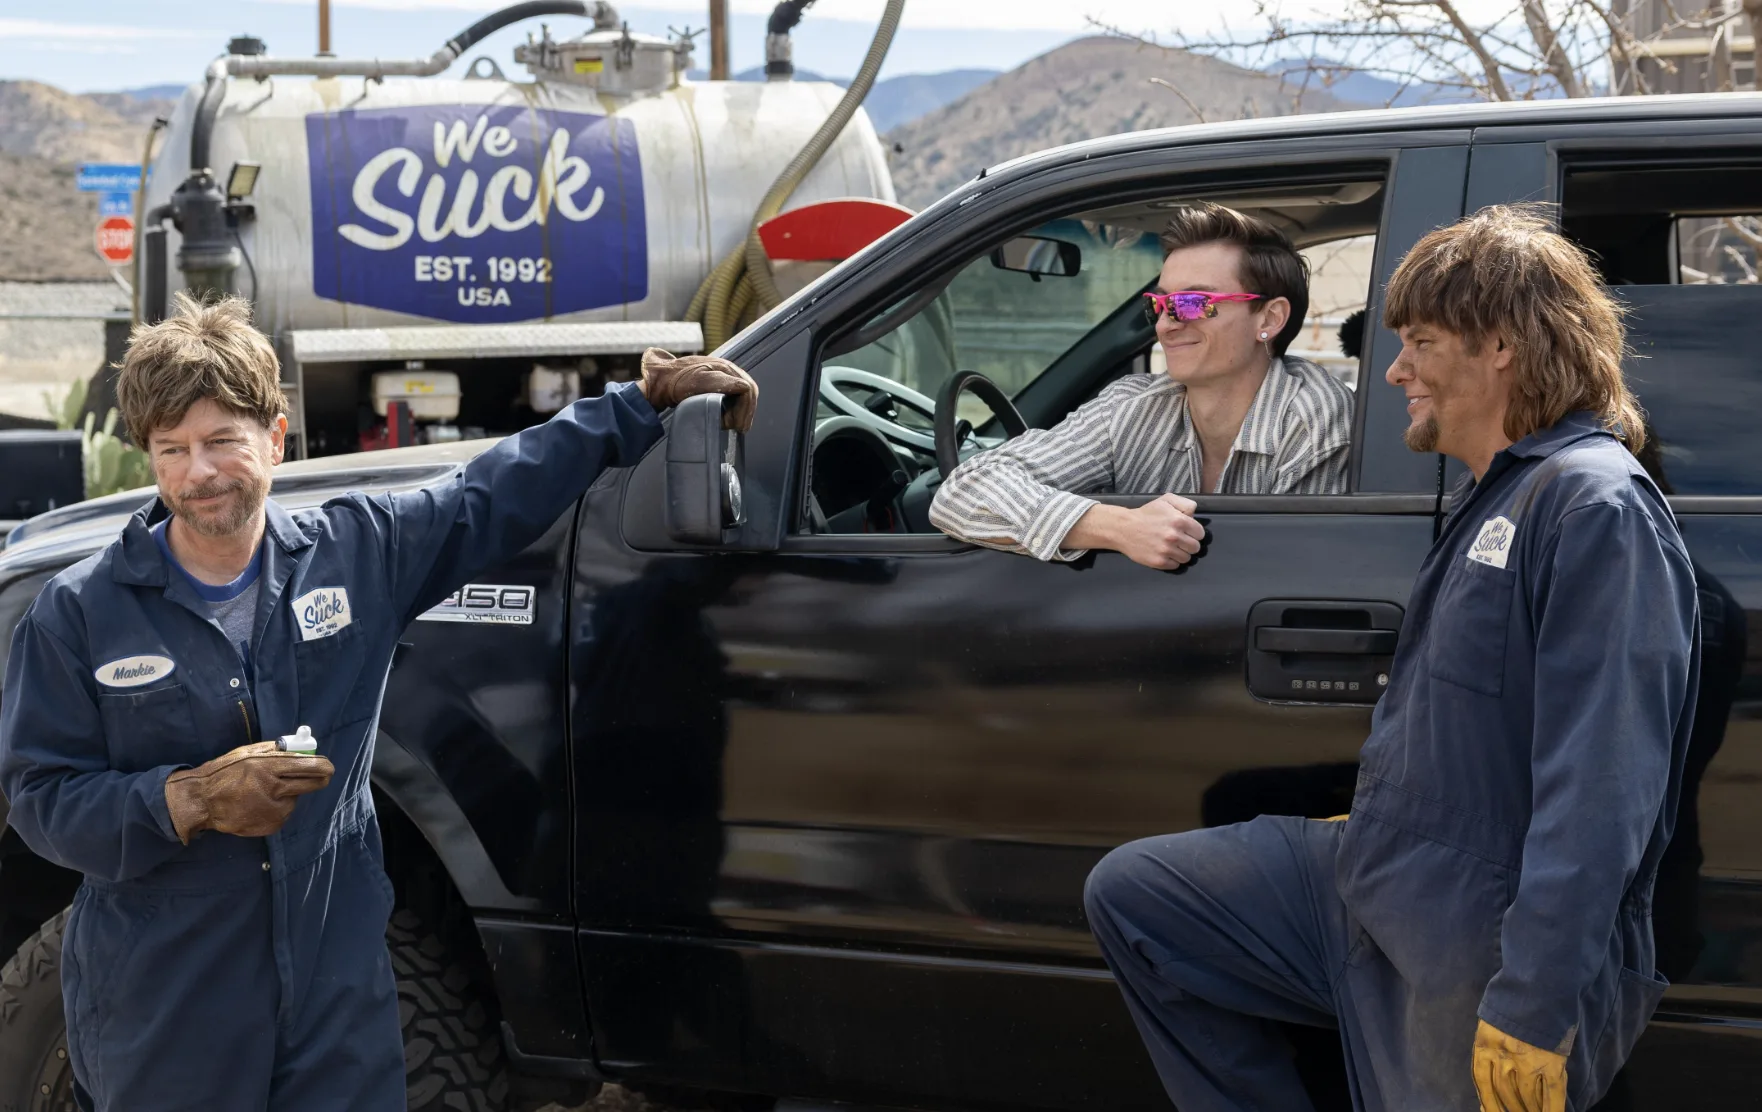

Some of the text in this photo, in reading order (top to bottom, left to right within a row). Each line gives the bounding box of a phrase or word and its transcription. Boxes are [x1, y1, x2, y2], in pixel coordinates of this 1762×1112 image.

[433, 115, 518, 168] We
[338, 127, 605, 250] Suck
[415, 256, 553, 282] EST. 1992
[458, 288, 511, 306] USA
[1474, 526, 1508, 552] Suck
[304, 591, 345, 629] Suck
[313, 591, 329, 608] We
[489, 613, 529, 622] TRITON
[112, 662, 156, 680] Markie
